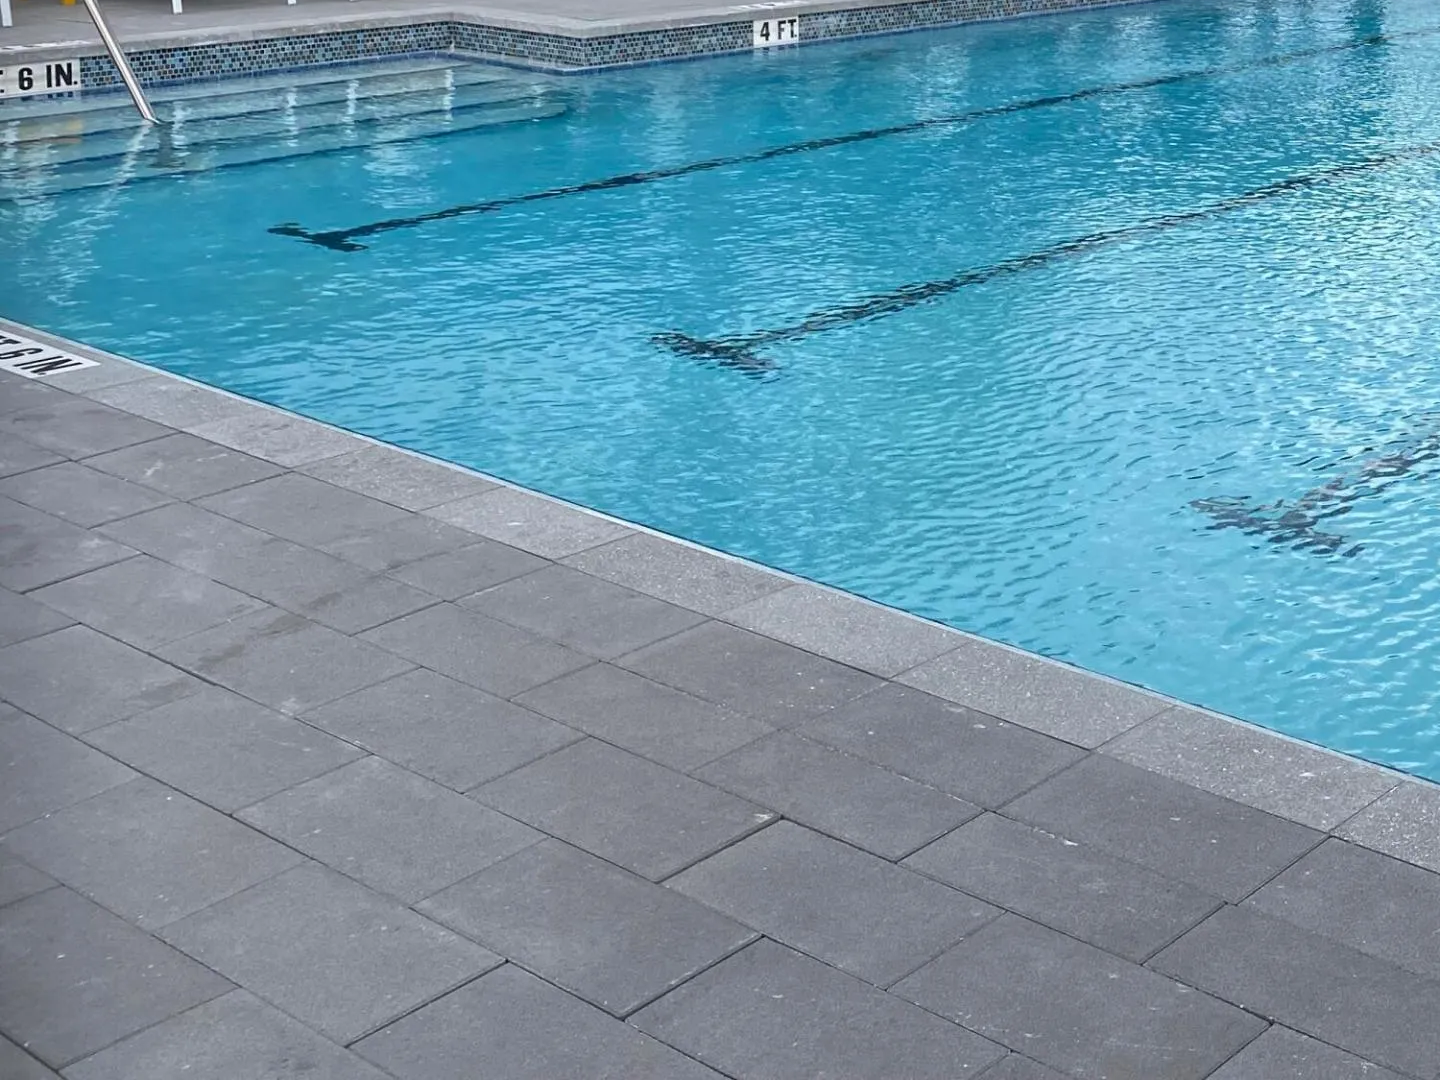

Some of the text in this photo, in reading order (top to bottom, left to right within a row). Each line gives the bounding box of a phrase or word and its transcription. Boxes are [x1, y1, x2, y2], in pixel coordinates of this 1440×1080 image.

[760, 18, 798, 41] 4 FT.
[18, 67, 33, 90] 6
[46, 62, 78, 88] IN.
[13, 355, 83, 375] IN.
